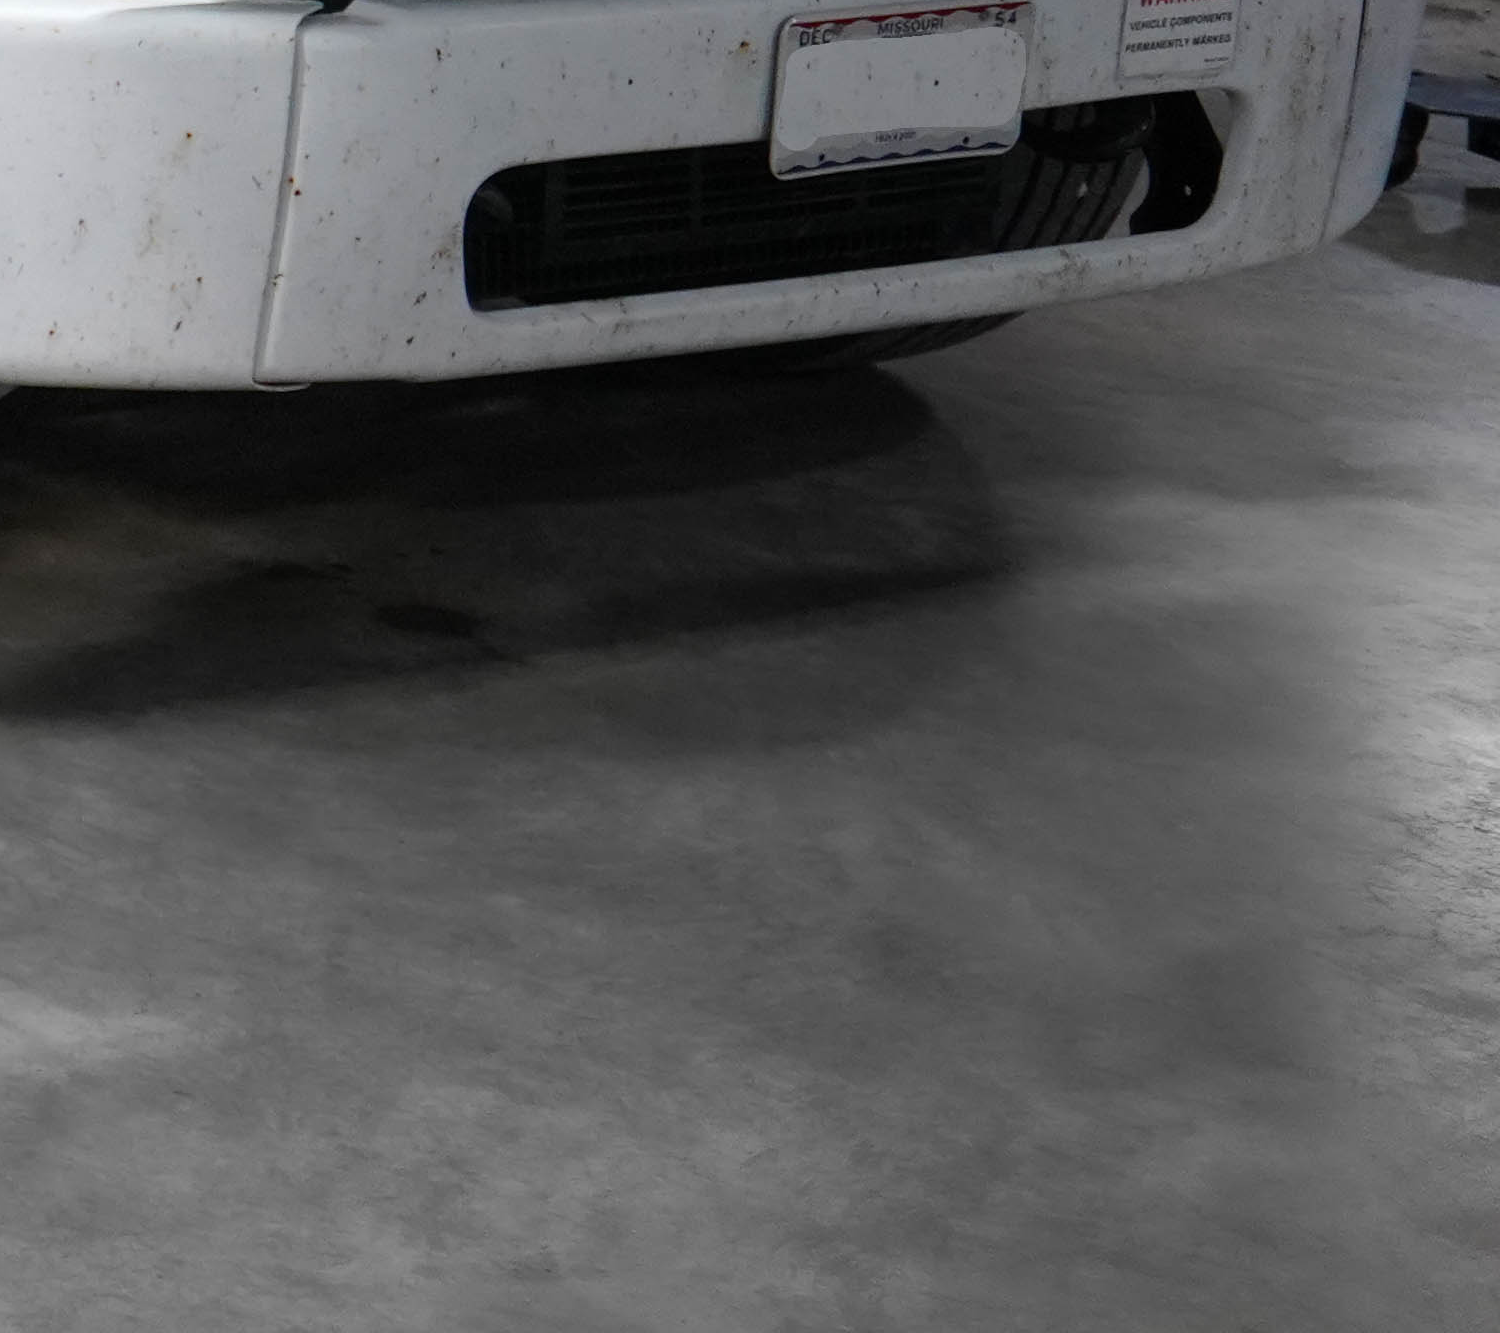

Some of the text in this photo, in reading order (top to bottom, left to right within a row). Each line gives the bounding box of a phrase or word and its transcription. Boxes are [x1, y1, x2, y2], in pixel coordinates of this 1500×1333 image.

[1130, 12, 1232, 31] VEHICLE COMPONENTS
[799, 28, 831, 47] DEC
[876, 17, 944, 36] MISSOURI
[1125, 33, 1232, 53] PERMANENTLY MARKED
